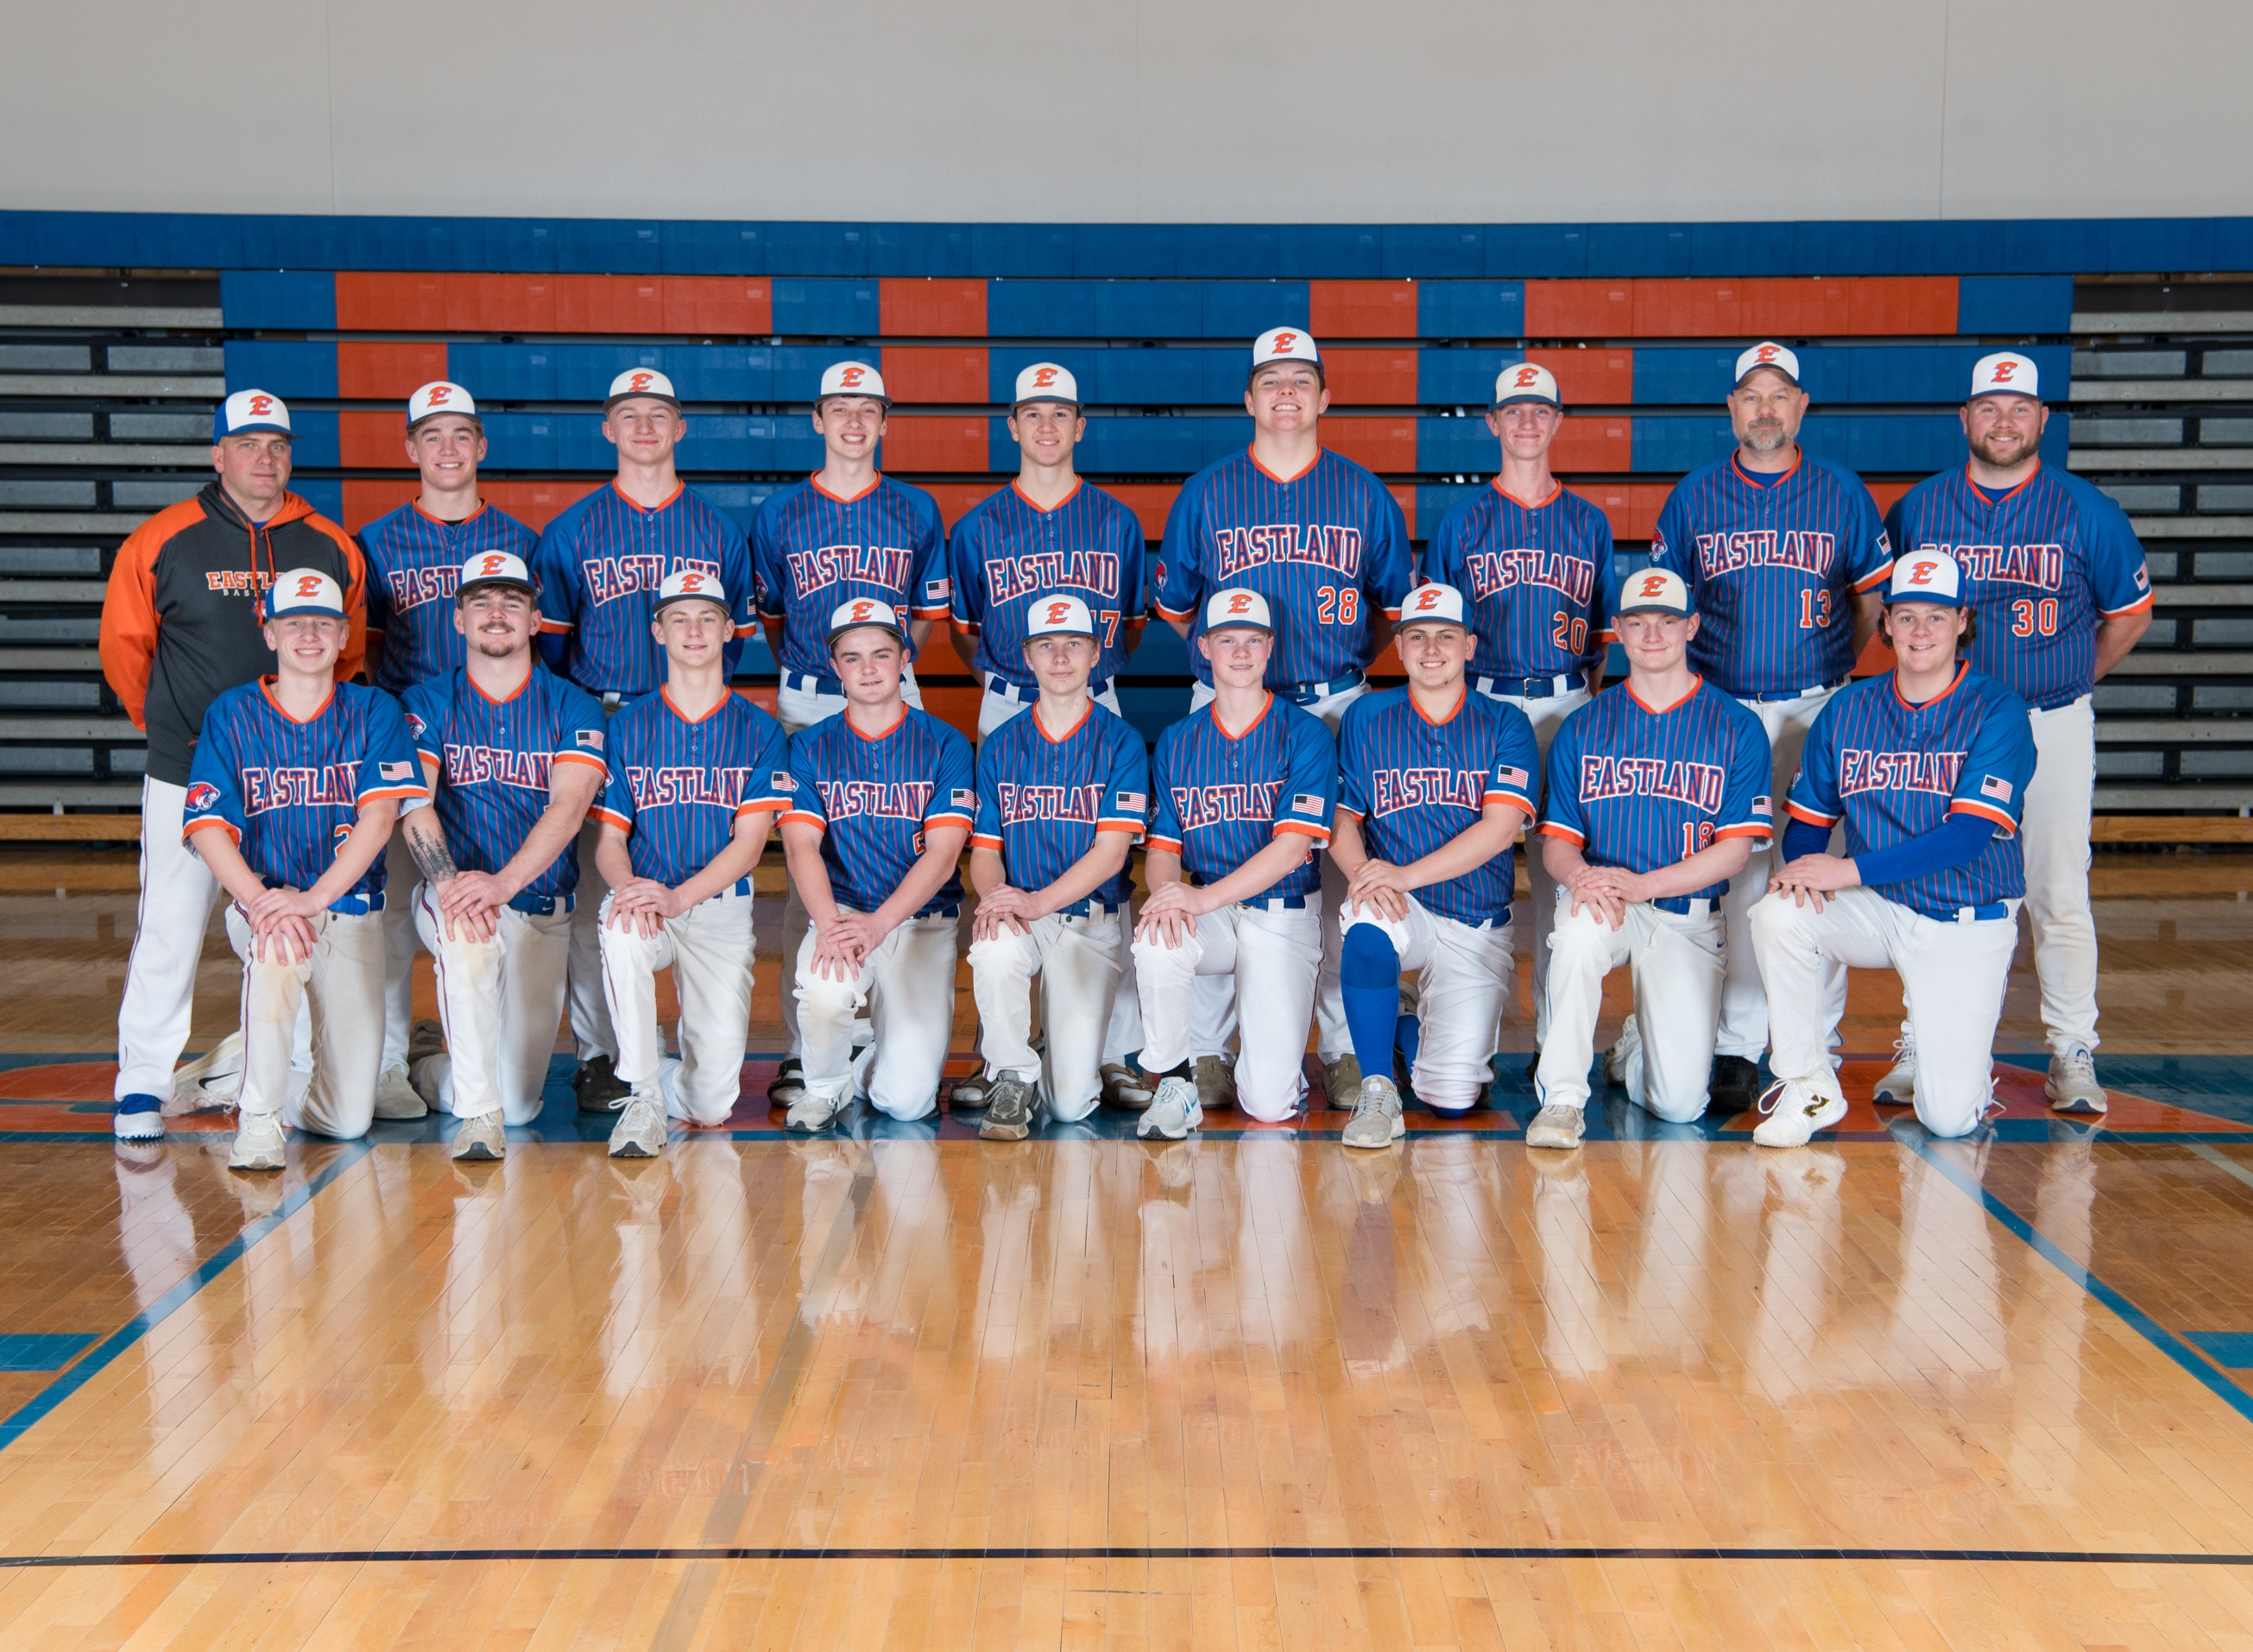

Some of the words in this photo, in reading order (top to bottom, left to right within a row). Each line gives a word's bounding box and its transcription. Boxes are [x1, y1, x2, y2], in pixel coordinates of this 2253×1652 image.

[1272, 332, 1297, 354] E
[1754, 344, 1781, 363] E
[628, 372, 653, 392] E
[841, 367, 866, 388] E
[1032, 367, 1058, 388] E
[1514, 367, 1539, 388] E
[1991, 361, 2017, 383] E
[249, 394, 274, 416] E
[427, 385, 452, 407] E
[1215, 524, 1361, 581] EASTLAND
[1696, 530, 1835, 582] EASTLAND
[480, 554, 507, 576] E
[786, 545, 912, 600] EASTLAND
[1909, 561, 1938, 585] E
[1921, 544, 2063, 591] STLAND
[205, 571, 286, 590] EASTL
[295, 576, 323, 597] E
[679, 573, 705, 593] E
[985, 551, 1120, 607] EASTLAND
[1467, 549, 1594, 608] EASTLAND
[1639, 575, 1668, 597] E
[1228, 593, 1253, 614] E
[1316, 586, 1360, 626] 28
[1415, 589, 1442, 610] E
[1800, 589, 1831, 629] 13
[849, 601, 874, 622] E
[1045, 602, 1071, 624] E
[2012, 598, 2058, 637] 30
[1090, 609, 1120, 648] 7
[1553, 610, 1587, 656] 20
[444, 744, 555, 791] EASTLAN
[1579, 756, 1725, 815] EASTLAND
[1171, 779, 1288, 833] EASTLAN
[1682, 822, 1714, 860] 18
